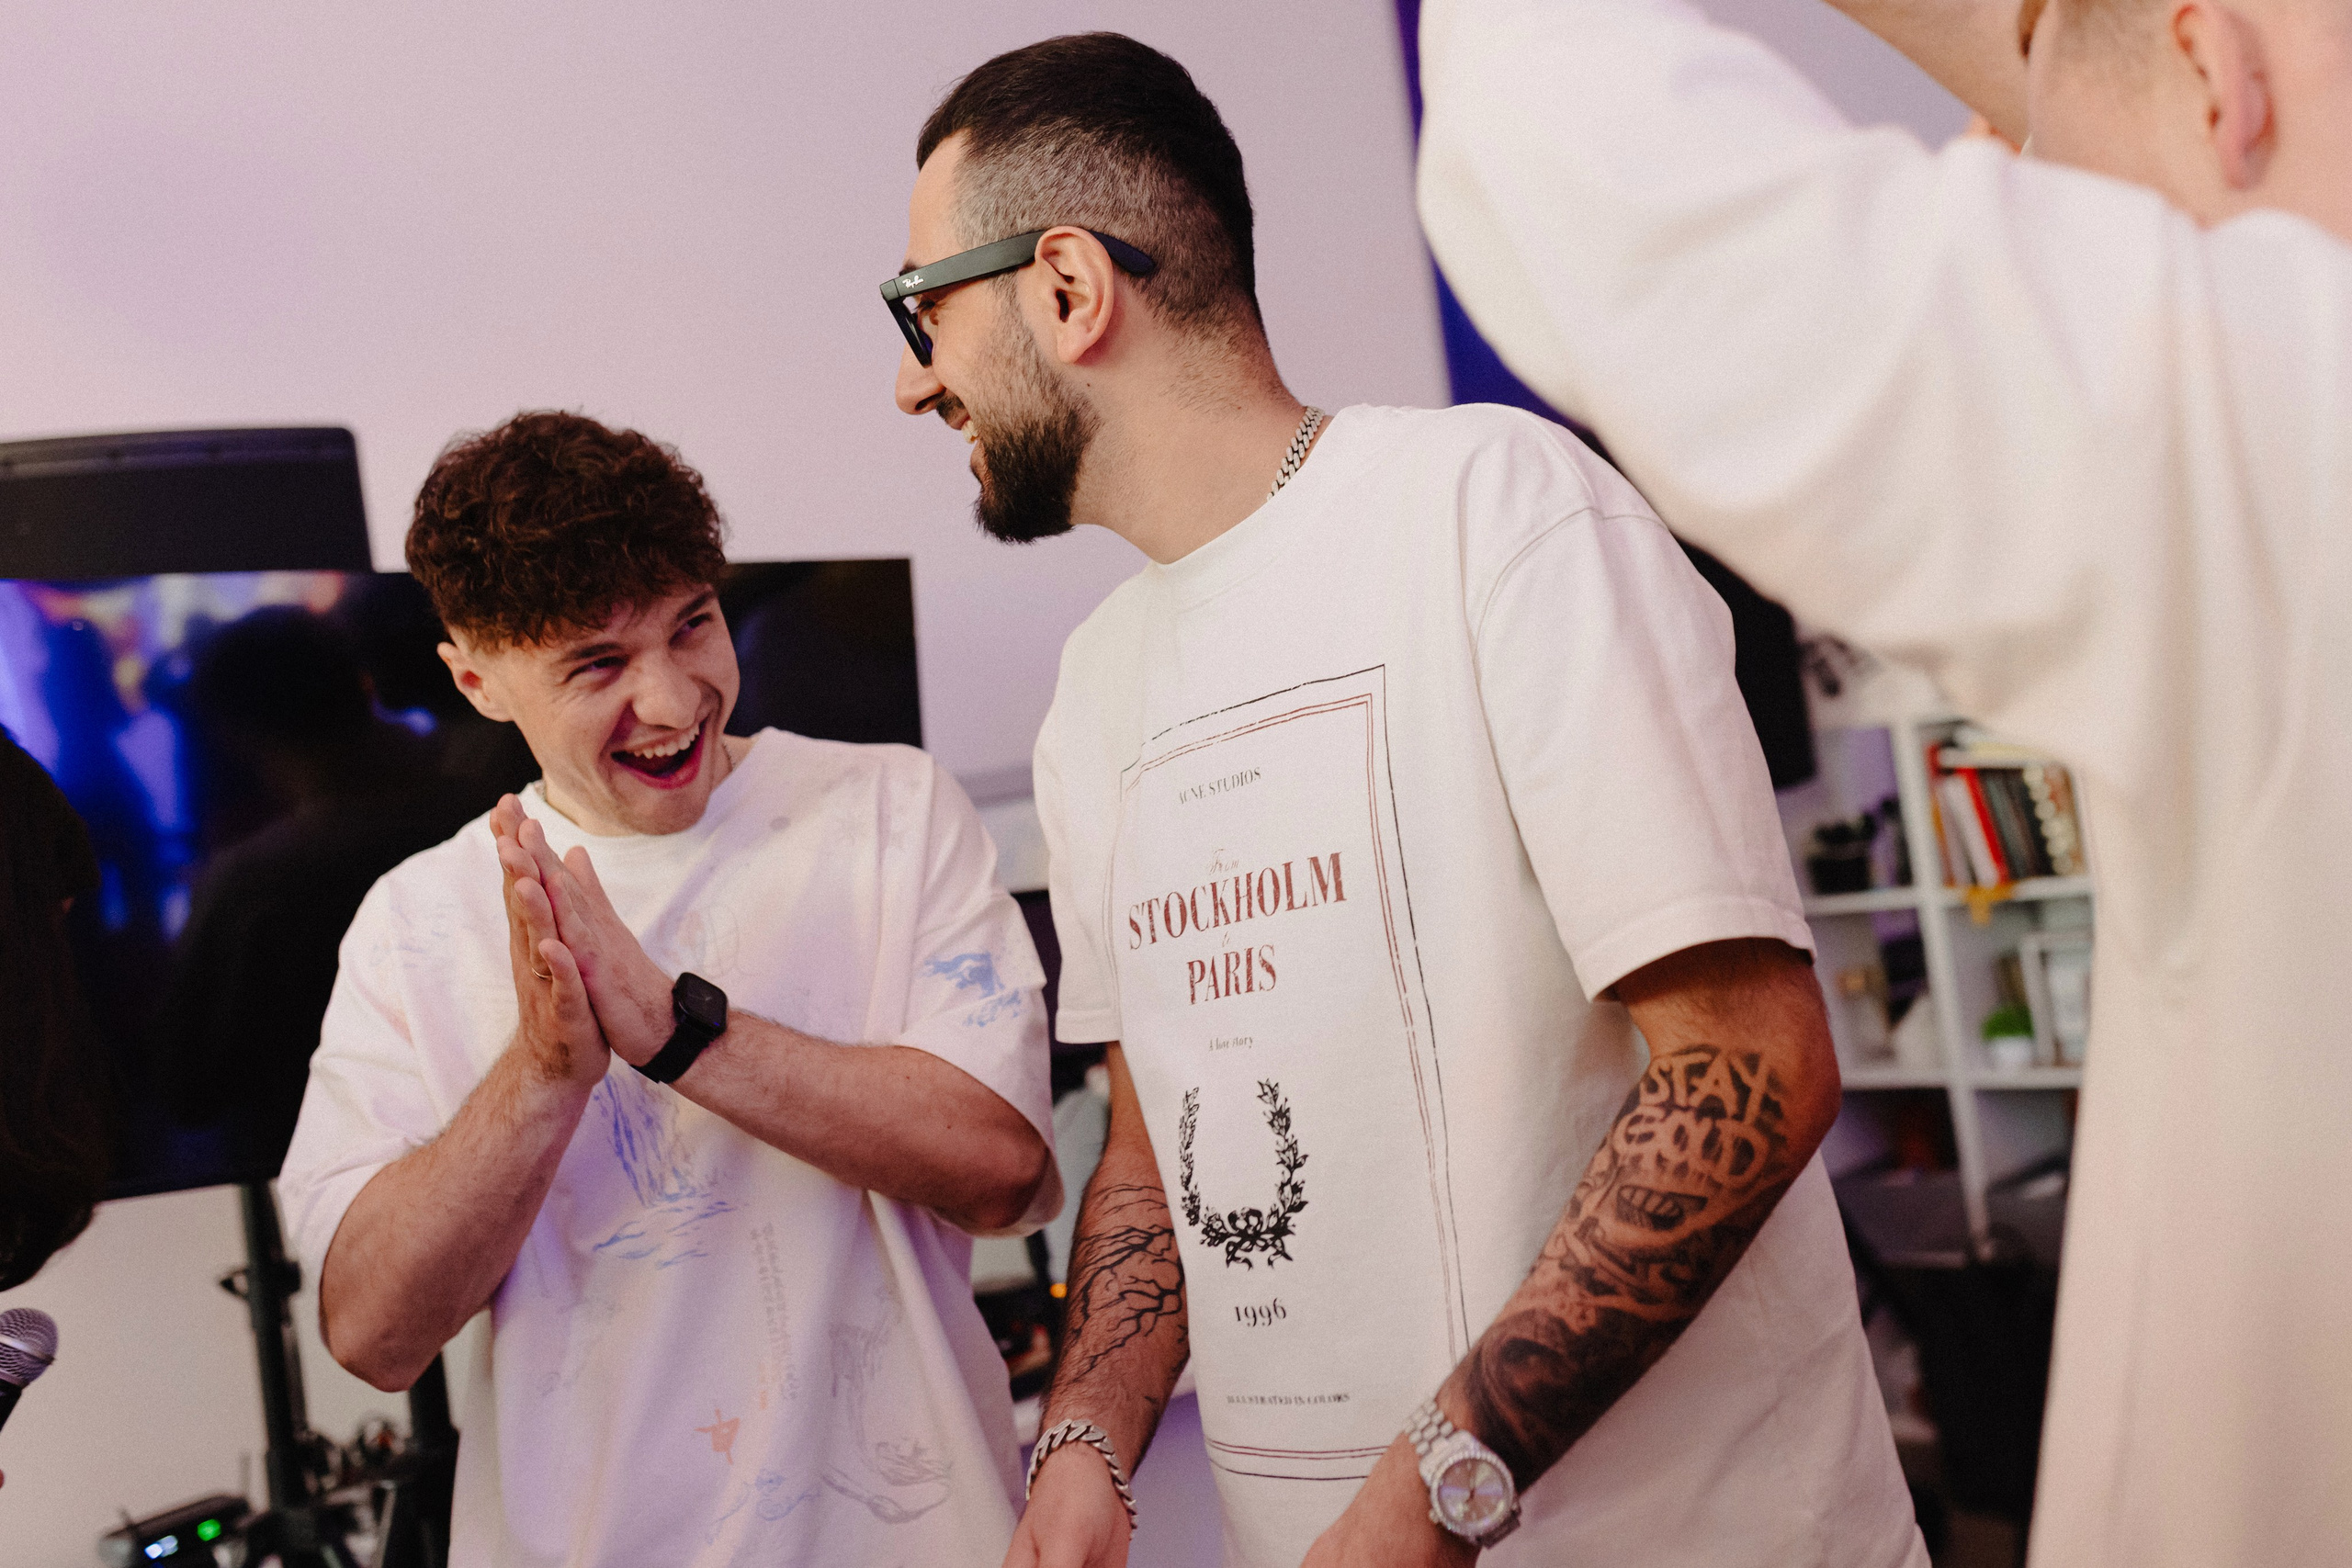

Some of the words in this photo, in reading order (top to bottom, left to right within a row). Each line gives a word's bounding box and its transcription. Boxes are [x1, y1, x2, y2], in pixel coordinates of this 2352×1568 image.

[1209, 766, 1261, 795] STUDIOS
[1128, 851, 1347, 950] STOCKHOLM
[1187, 944, 1276, 1005] PARIS
[1639, 1051, 1771, 1123] STAY
[1611, 1105, 1770, 1188] GOLD
[1235, 1297, 1287, 1327] 1996
